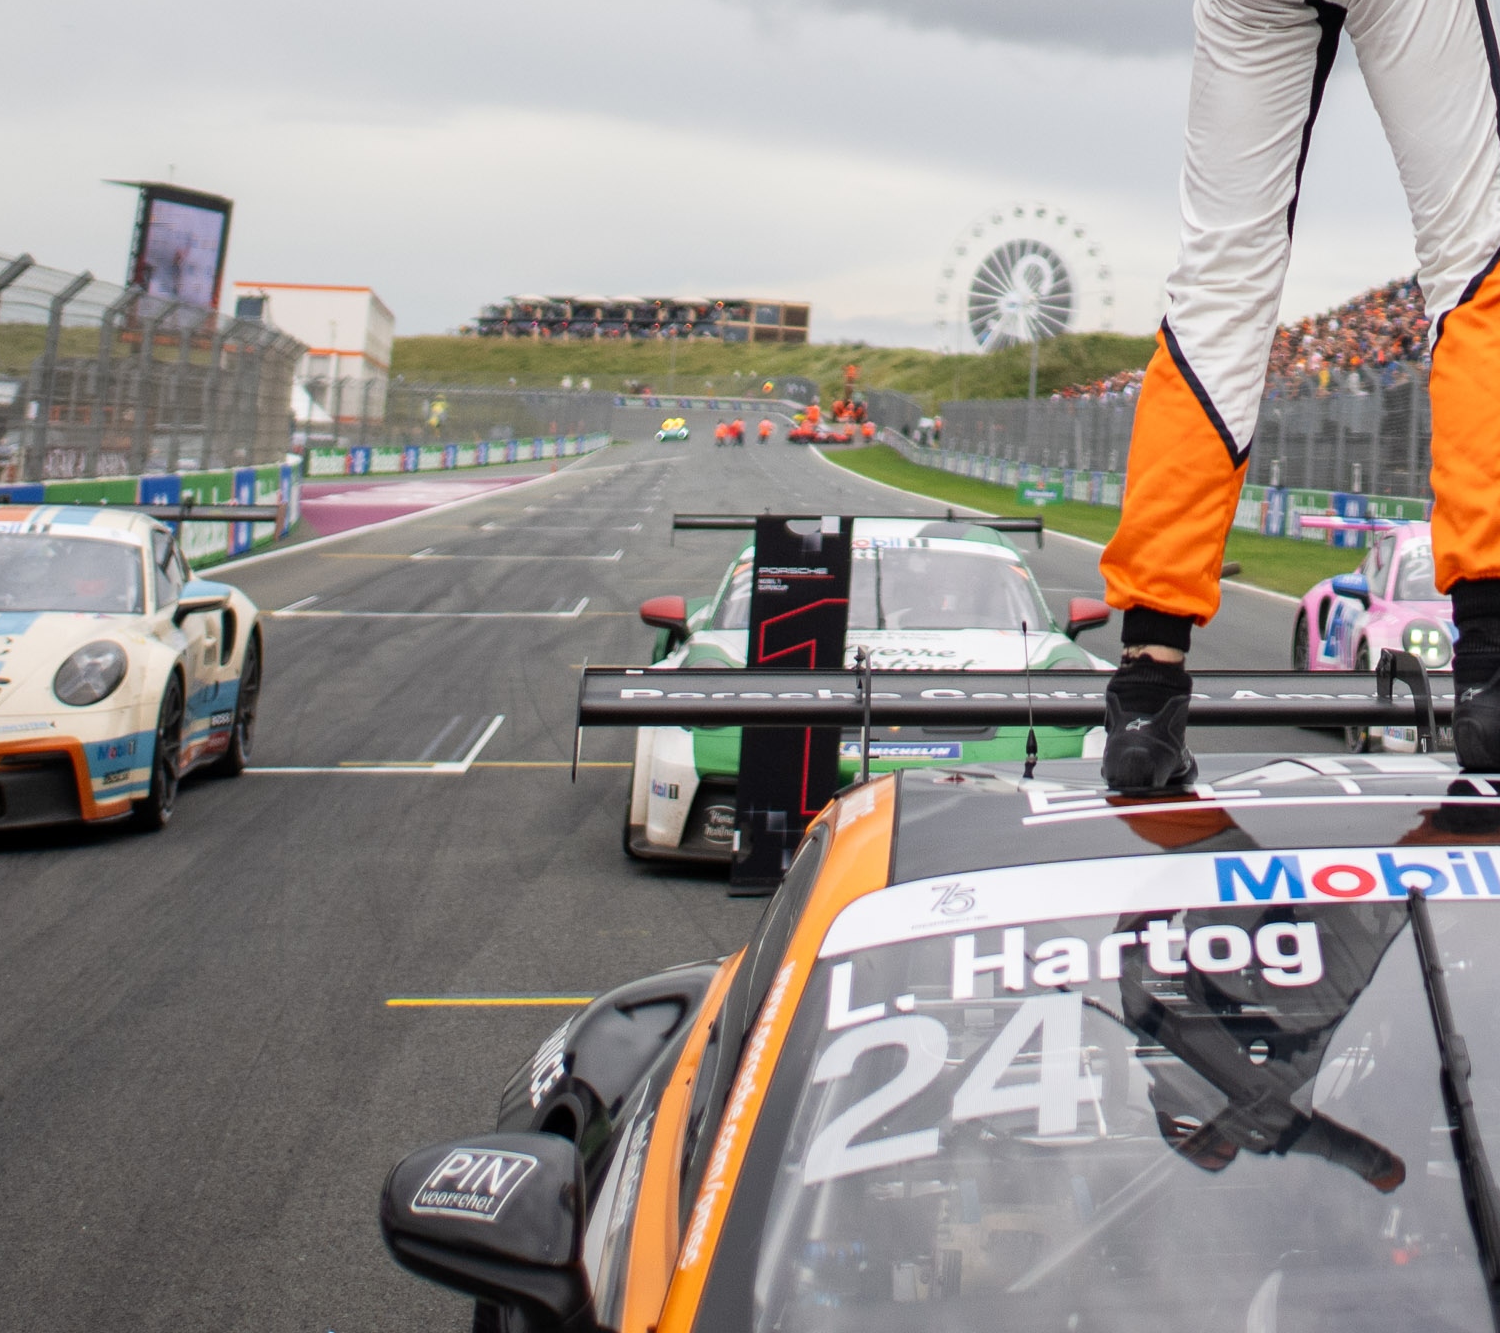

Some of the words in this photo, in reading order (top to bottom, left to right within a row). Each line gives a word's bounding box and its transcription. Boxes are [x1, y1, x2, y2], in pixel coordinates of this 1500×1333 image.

[853, 537, 901, 548] obil
[758, 566, 828, 575] PORSCHE
[618, 688, 902, 700] Porsche
[871, 746, 952, 758] MICHELIN
[825, 960, 916, 1032] L.
[951, 916, 1325, 999] Hartog
[802, 989, 1106, 1185] 24
[430, 1152, 522, 1194] PIN
